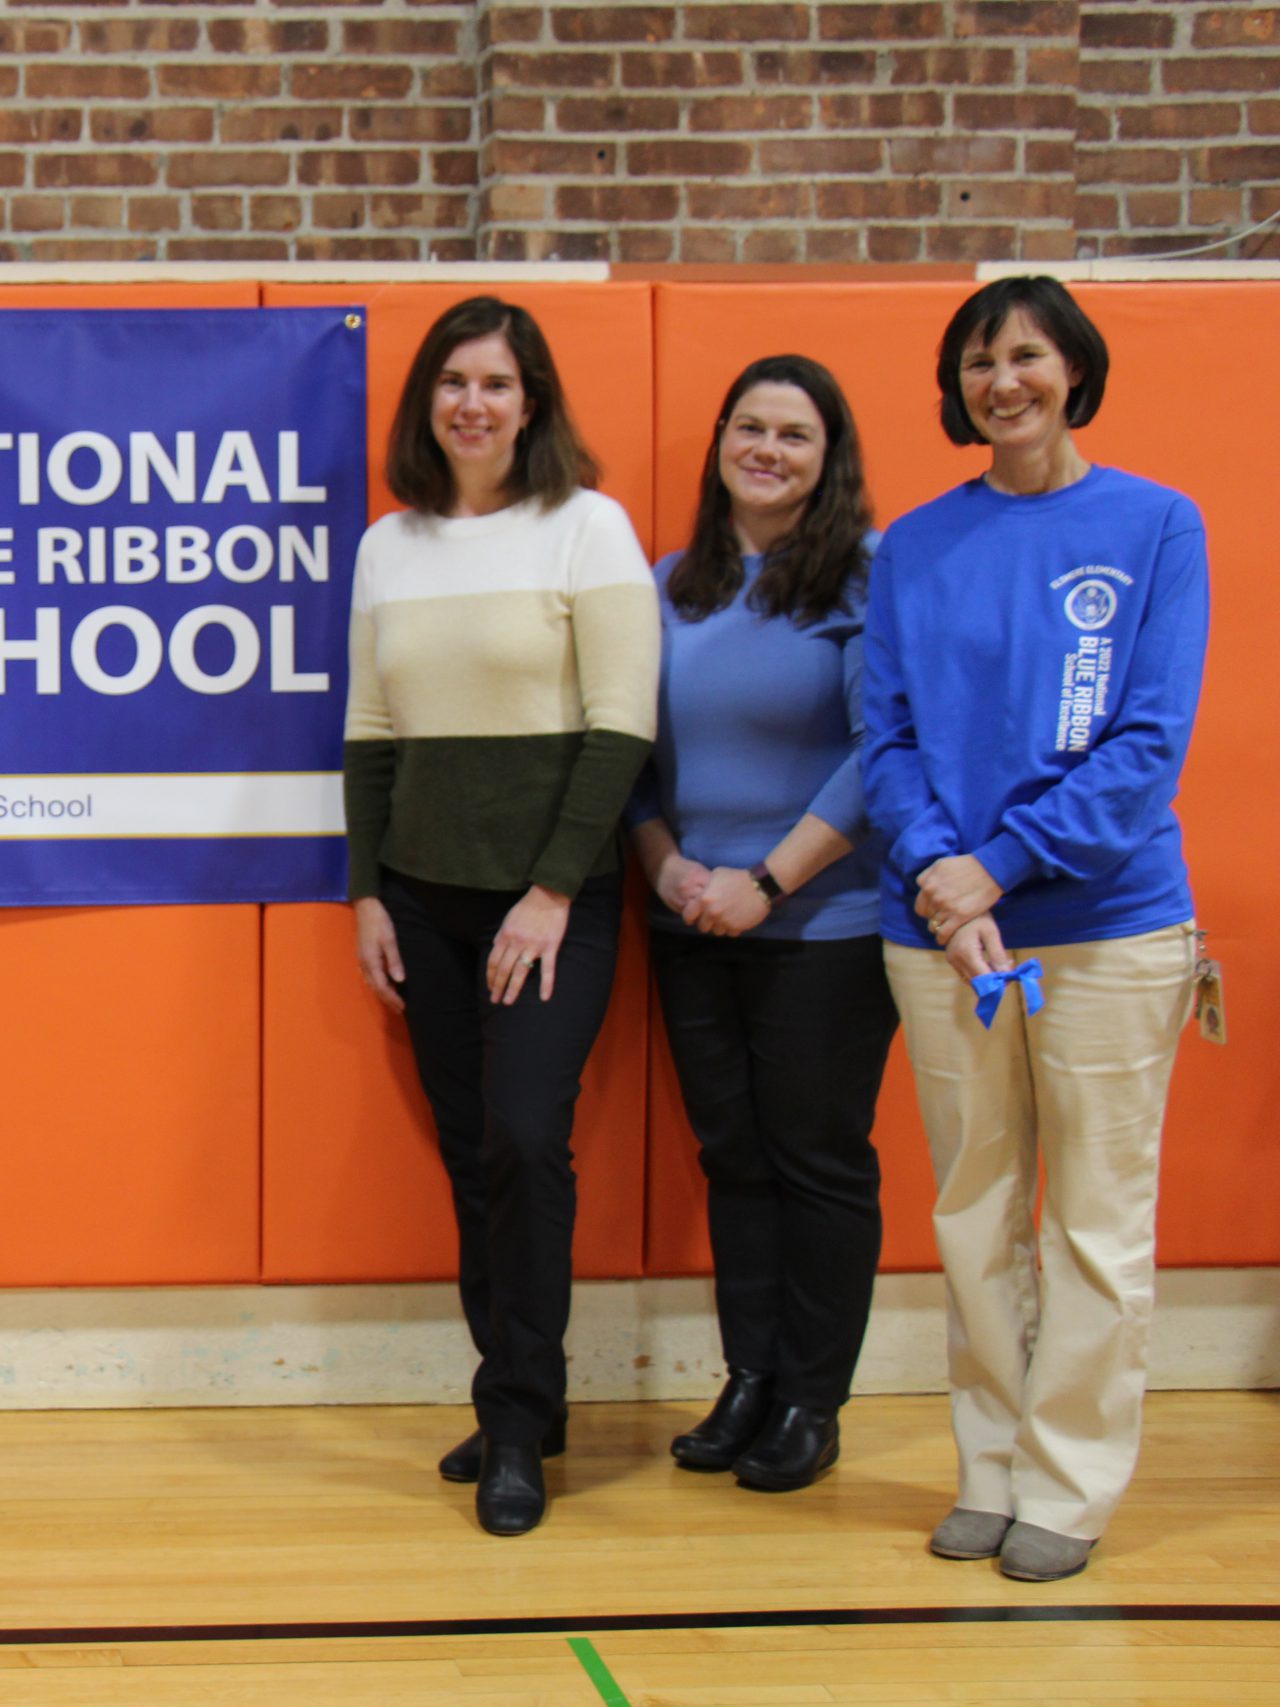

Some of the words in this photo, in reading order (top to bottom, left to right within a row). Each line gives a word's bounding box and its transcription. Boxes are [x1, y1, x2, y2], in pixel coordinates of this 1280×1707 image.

[37, 523, 330, 585] RIBBON
[1075, 636, 1099, 682] BLUE
[1097, 646, 1113, 672] 2022
[1100, 636, 1114, 646] A
[1061, 652, 1078, 687] School
[1060, 688, 1073, 699] of
[1093, 673, 1110, 717] National
[1067, 686, 1094, 752] RIBBON
